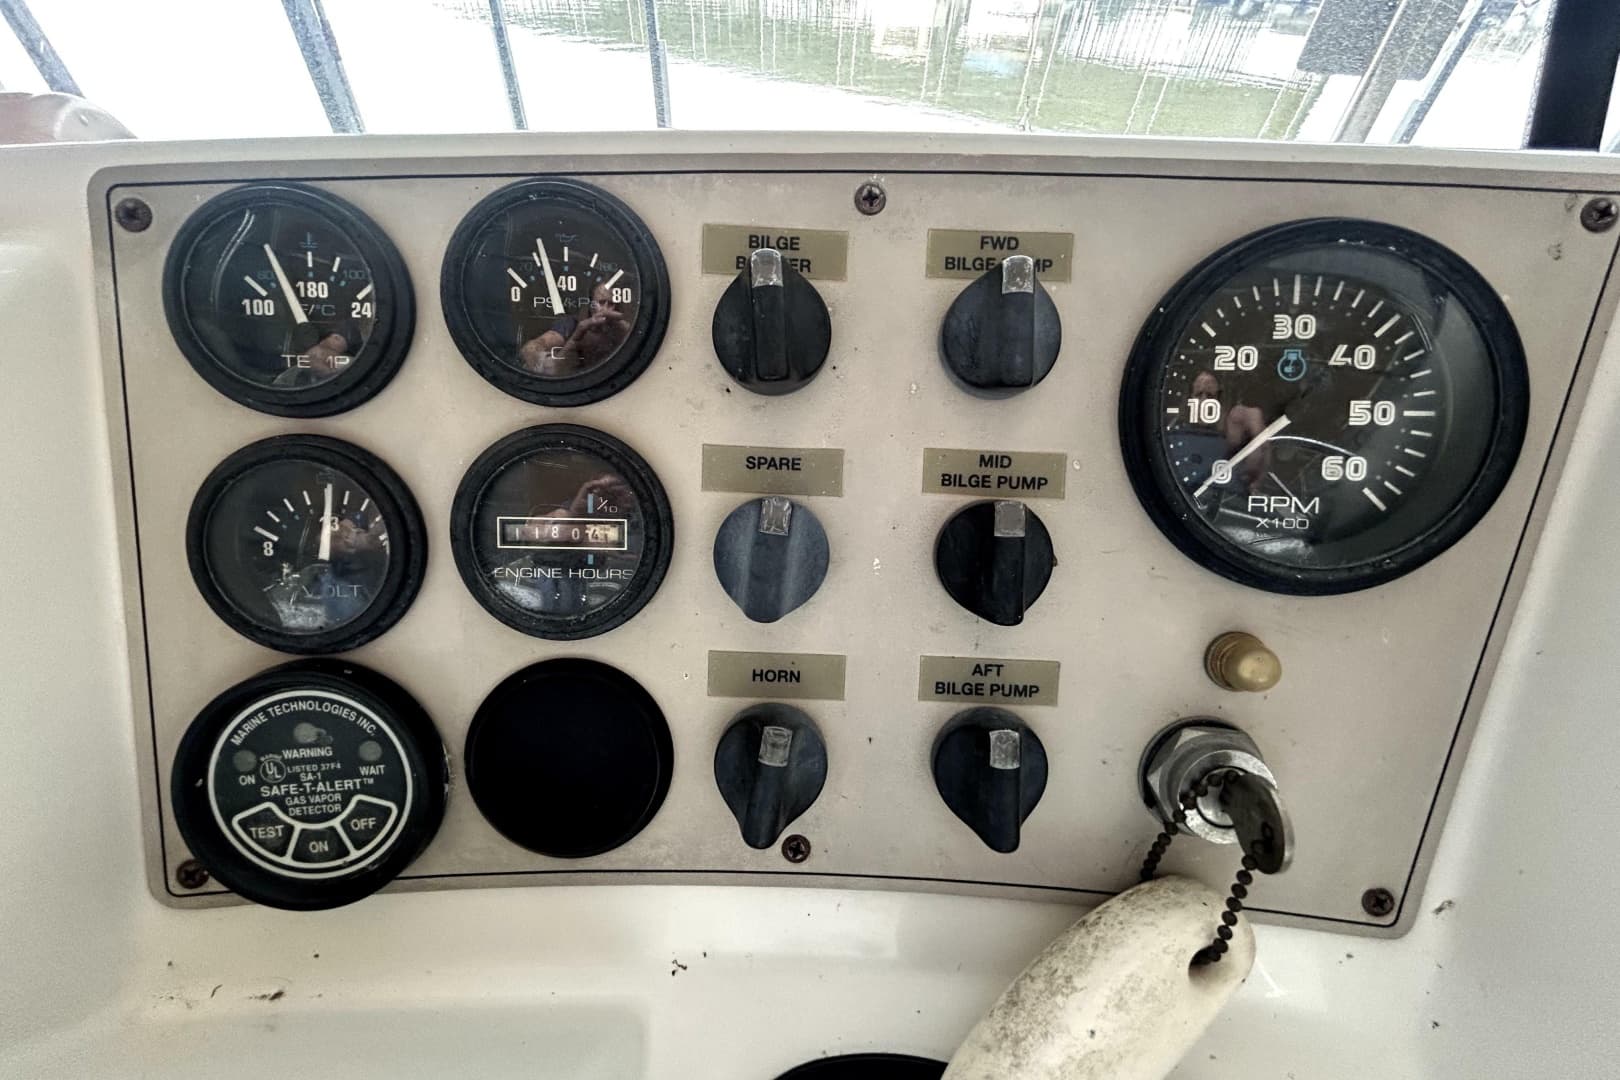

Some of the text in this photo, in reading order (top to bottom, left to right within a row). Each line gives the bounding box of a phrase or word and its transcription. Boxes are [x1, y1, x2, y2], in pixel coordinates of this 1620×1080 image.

[748, 235, 800, 250] BILGE
[980, 235, 1019, 250] FWD
[736, 256, 811, 273] BER
[296, 281, 328, 298] 180
[557, 275, 577, 292] 40
[510, 286, 521, 303] 0
[611, 287, 632, 304] 80
[241, 298, 275, 316] 100
[1272, 314, 1317, 340] 30
[1214, 345, 1259, 371] 20
[1328, 344, 1376, 370] 40
[1187, 398, 1221, 424] 10
[1348, 401, 1396, 426] 50
[745, 456, 802, 471] SPARE
[978, 454, 1012, 469] MID
[1321, 456, 1368, 481] 60
[941, 474, 1048, 490] BILGE PUMP
[1247, 495, 1320, 514] RPM
[1255, 518, 1310, 530] X100
[263, 541, 275, 557] 8
[493, 567, 634, 580] ENGINE HOURS
[752, 668, 801, 684] HORN
[972, 664, 1004, 678] AFT
[934, 682, 1040, 699] BILGE PUMP
[230, 711, 268, 746] MARINE
[267, 700, 358, 722] TECHNOLOGIES
[282, 746, 334, 760] WARNING
[287, 763, 319, 774] LISTED
[359, 764, 386, 777] WAIT
[239, 775, 256, 787] ON
[300, 772, 322, 782] SA-1
[284, 793, 343, 807] GAS VAPOR
[288, 803, 343, 817] DETECTOR
[249, 824, 285, 839] TEST
[350, 817, 377, 831] OFF
[308, 841, 329, 853] ON
